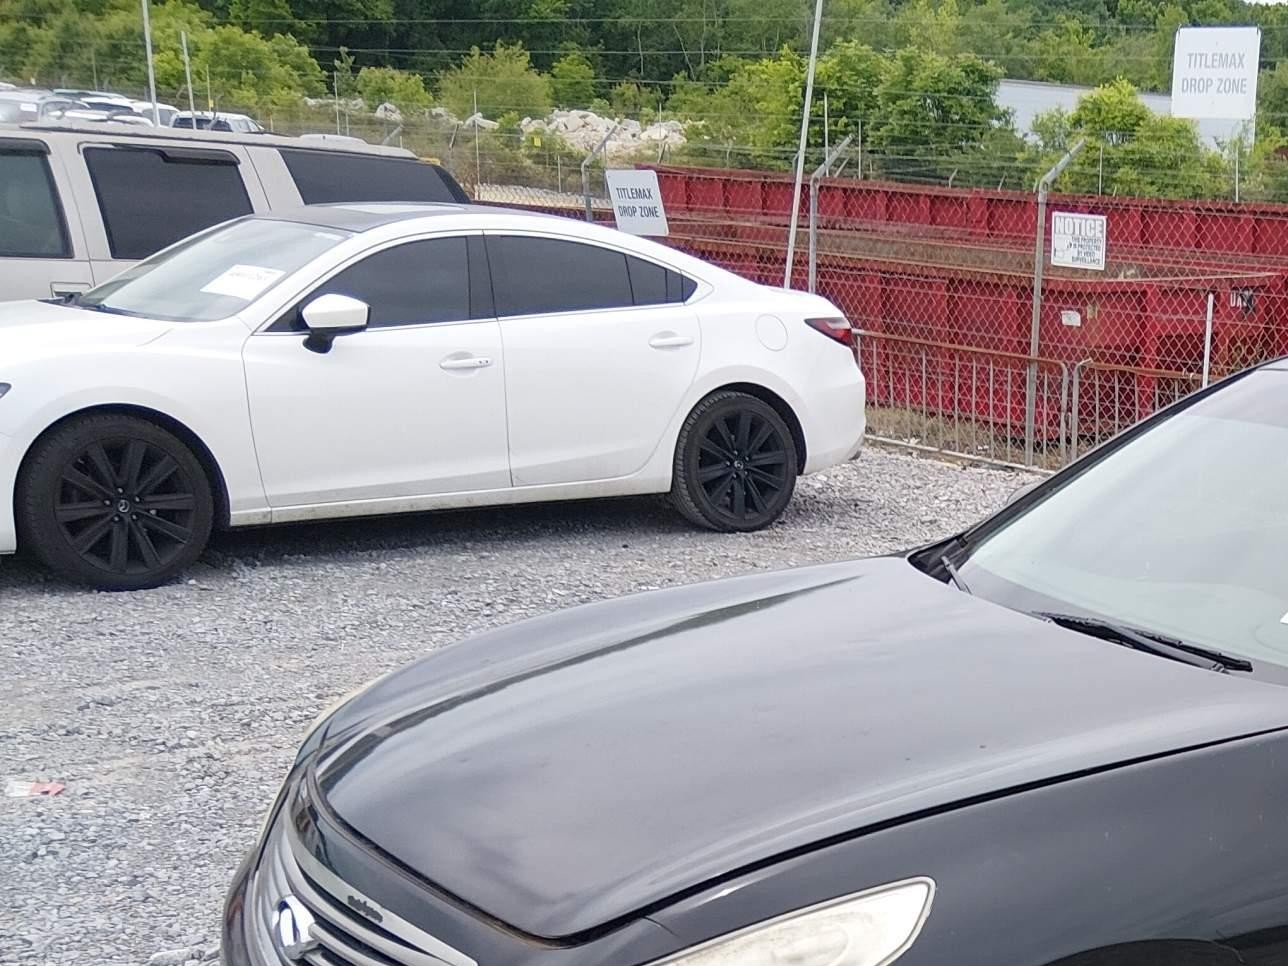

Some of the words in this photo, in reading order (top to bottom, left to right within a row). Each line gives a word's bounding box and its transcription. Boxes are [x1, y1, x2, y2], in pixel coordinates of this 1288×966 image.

[1187, 52, 1246, 69] TITLEMAX
[1181, 78, 1213, 94] DROP
[1216, 78, 1248, 94] ZONE
[615, 187, 653, 200] TITLEMAX
[618, 205, 637, 218] DROP
[638, 205, 660, 218] ZONE
[1054, 216, 1104, 237] NOTICE
